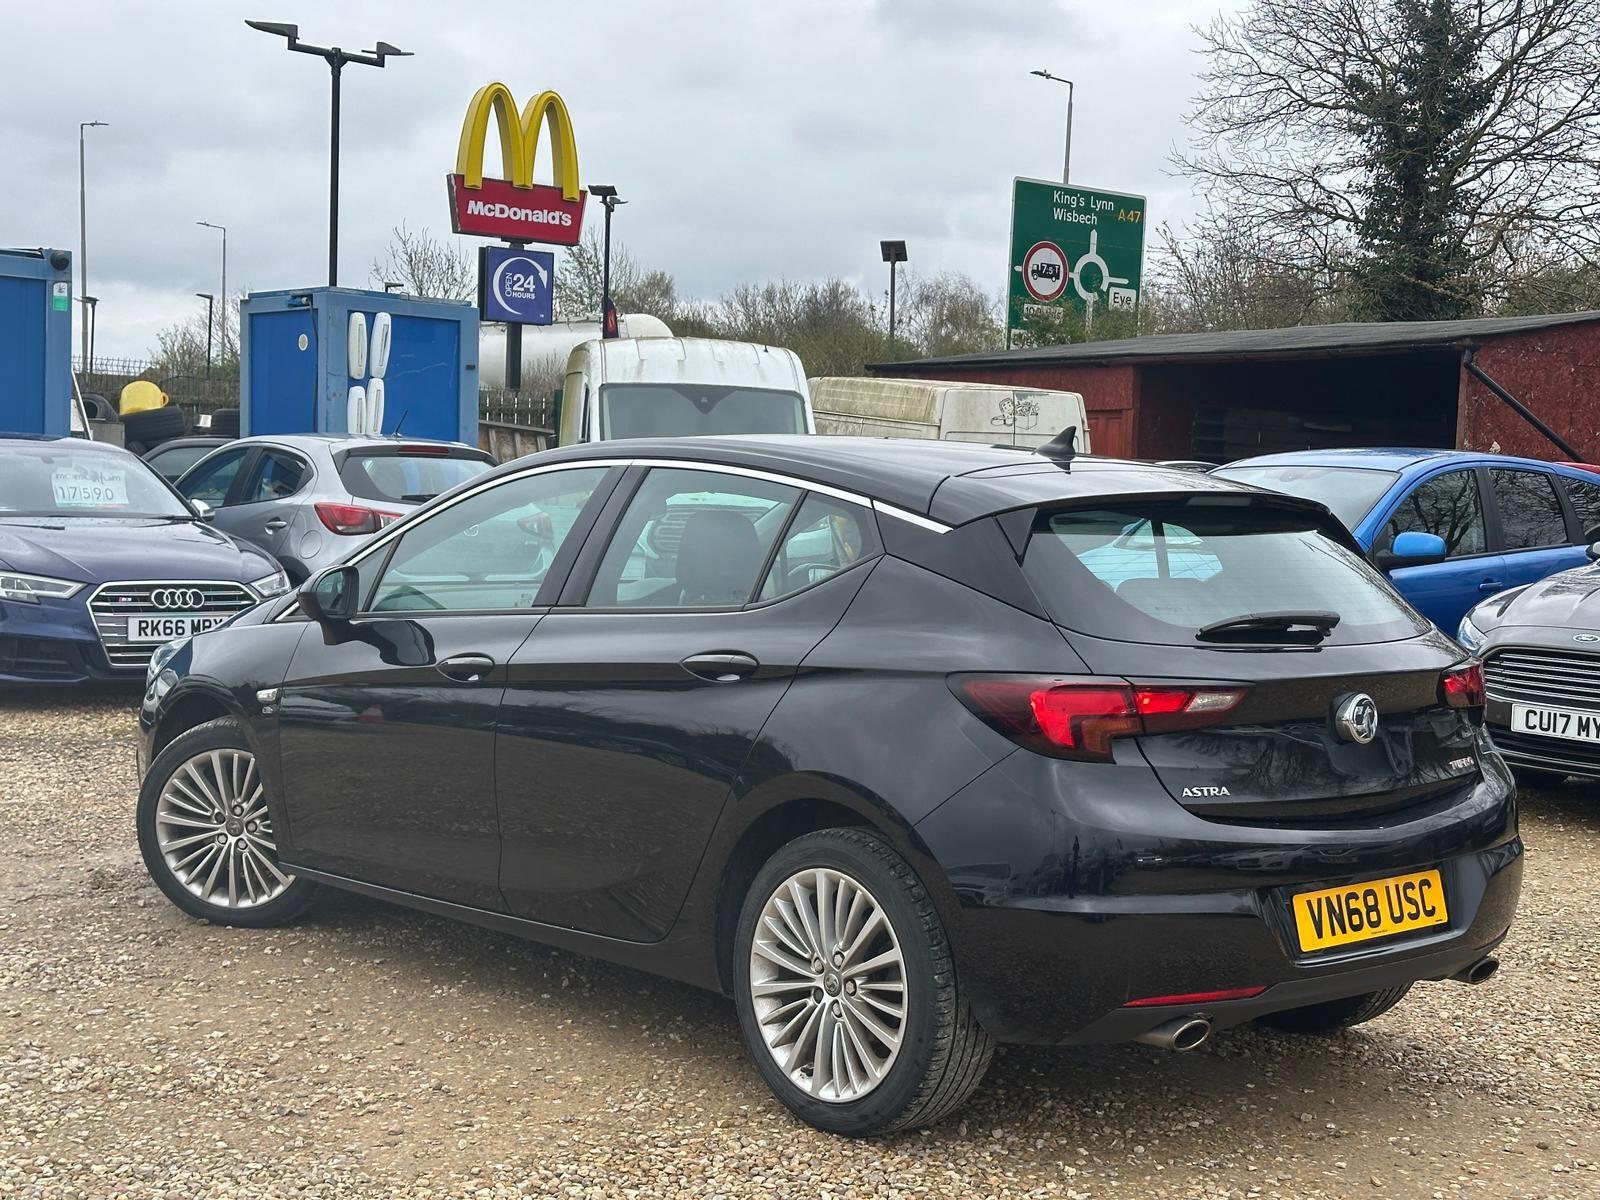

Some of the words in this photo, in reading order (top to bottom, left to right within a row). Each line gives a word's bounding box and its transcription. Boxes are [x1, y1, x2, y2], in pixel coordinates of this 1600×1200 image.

[1053, 190, 1086, 208] King's
[1090, 195, 1115, 211] Lynn
[467, 200, 572, 227] McDonald's
[1053, 207, 1098, 225] Wisbech
[1117, 209, 1141, 224] A47
[505, 272, 513, 297] OPEN
[512, 273, 536, 292] 24
[512, 291, 535, 300] HOURS
[1113, 292, 1132, 306] Eye
[58, 486, 114, 501] 17590
[138, 619, 185, 637] RK66
[1525, 709, 1571, 735] CU17
[1577, 715, 1600, 739] MY
[1181, 785, 1231, 798] ASTRA
[1306, 888, 1382, 940] VN68
[1385, 878, 1436, 925] USC
